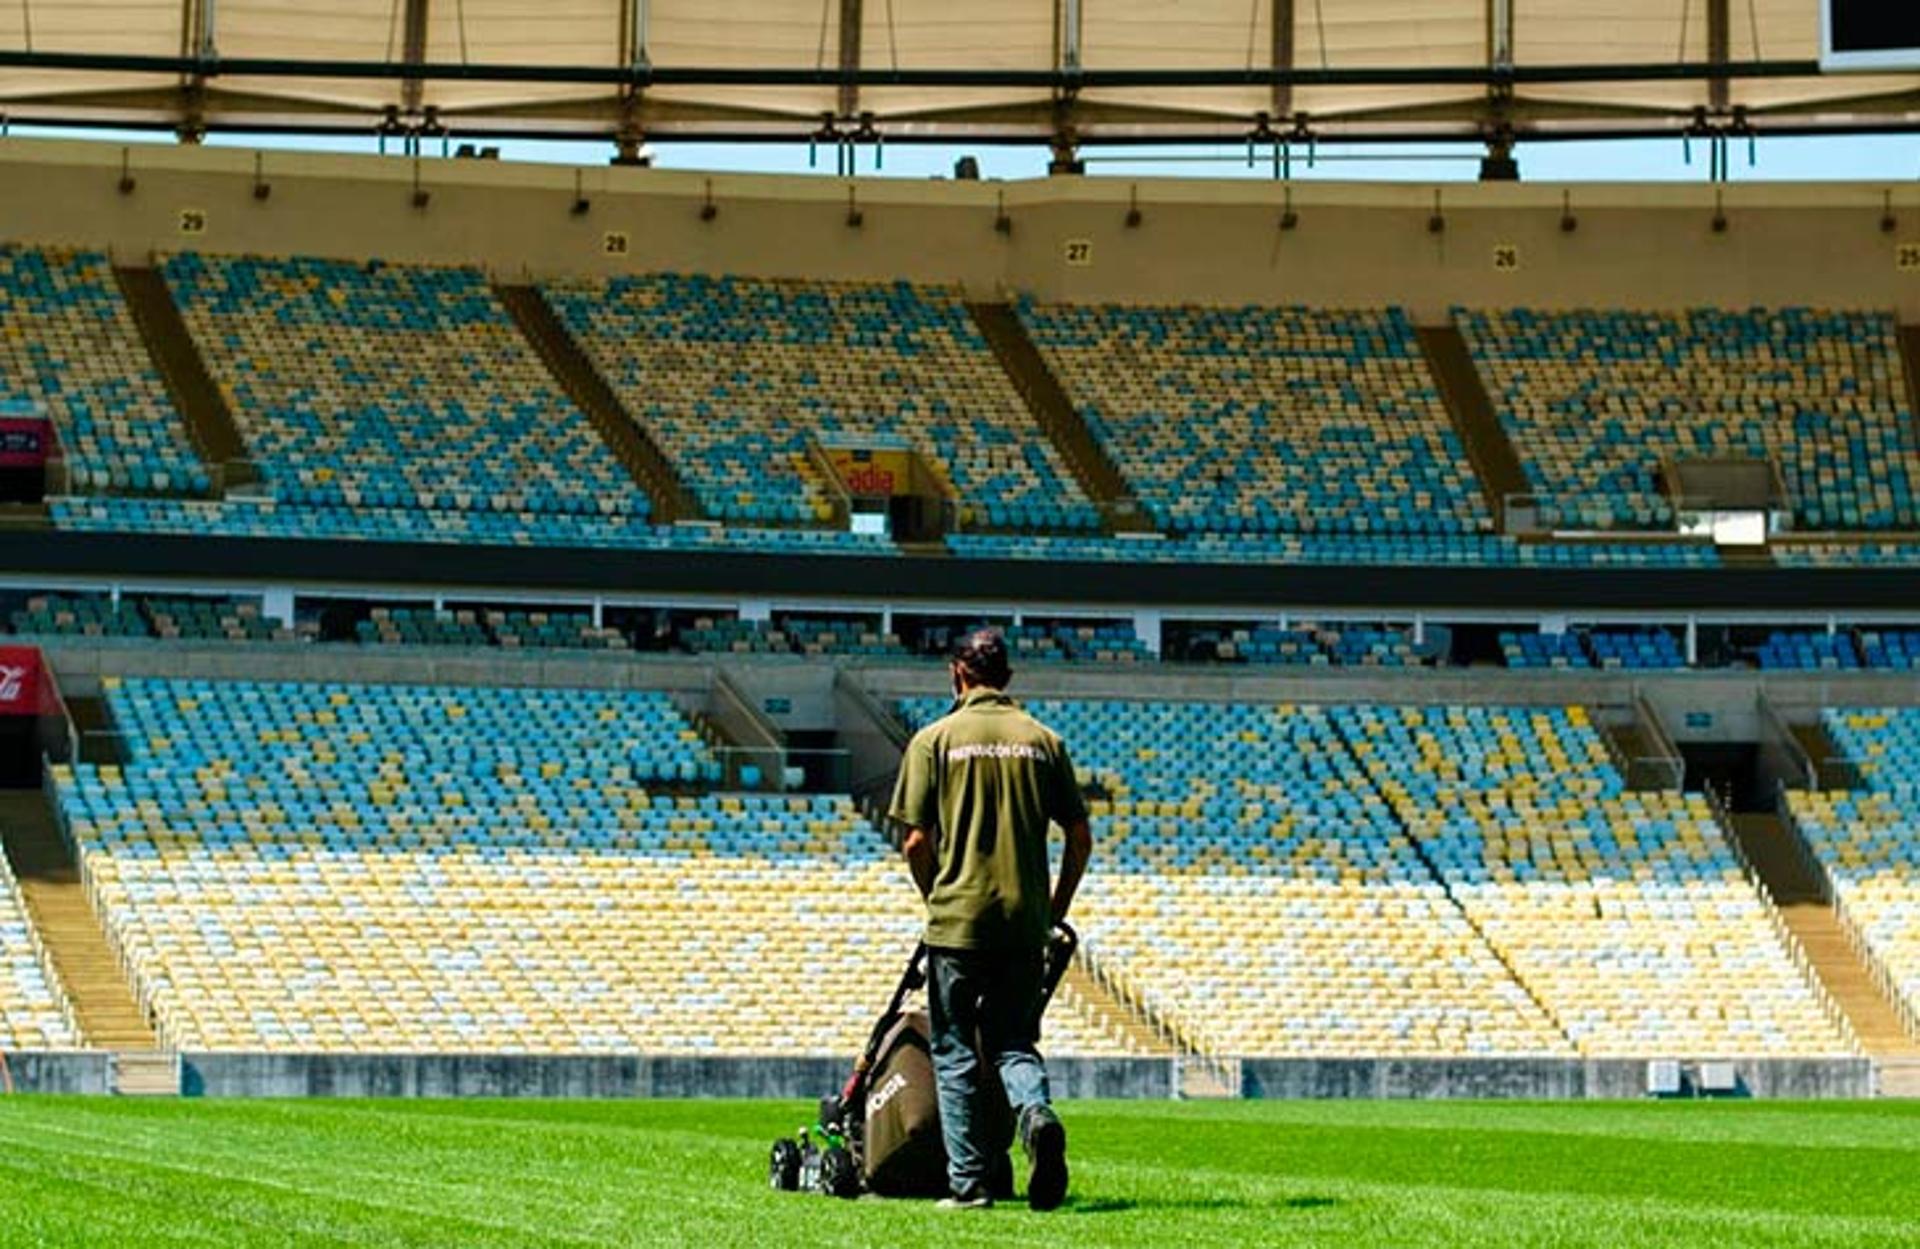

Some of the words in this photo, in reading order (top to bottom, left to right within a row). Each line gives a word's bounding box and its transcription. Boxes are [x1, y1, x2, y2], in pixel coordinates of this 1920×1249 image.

[183, 213, 203, 231] 29
[606, 235, 626, 253] 28
[1069, 244, 1088, 261] 27
[1496, 249, 1516, 267] 26
